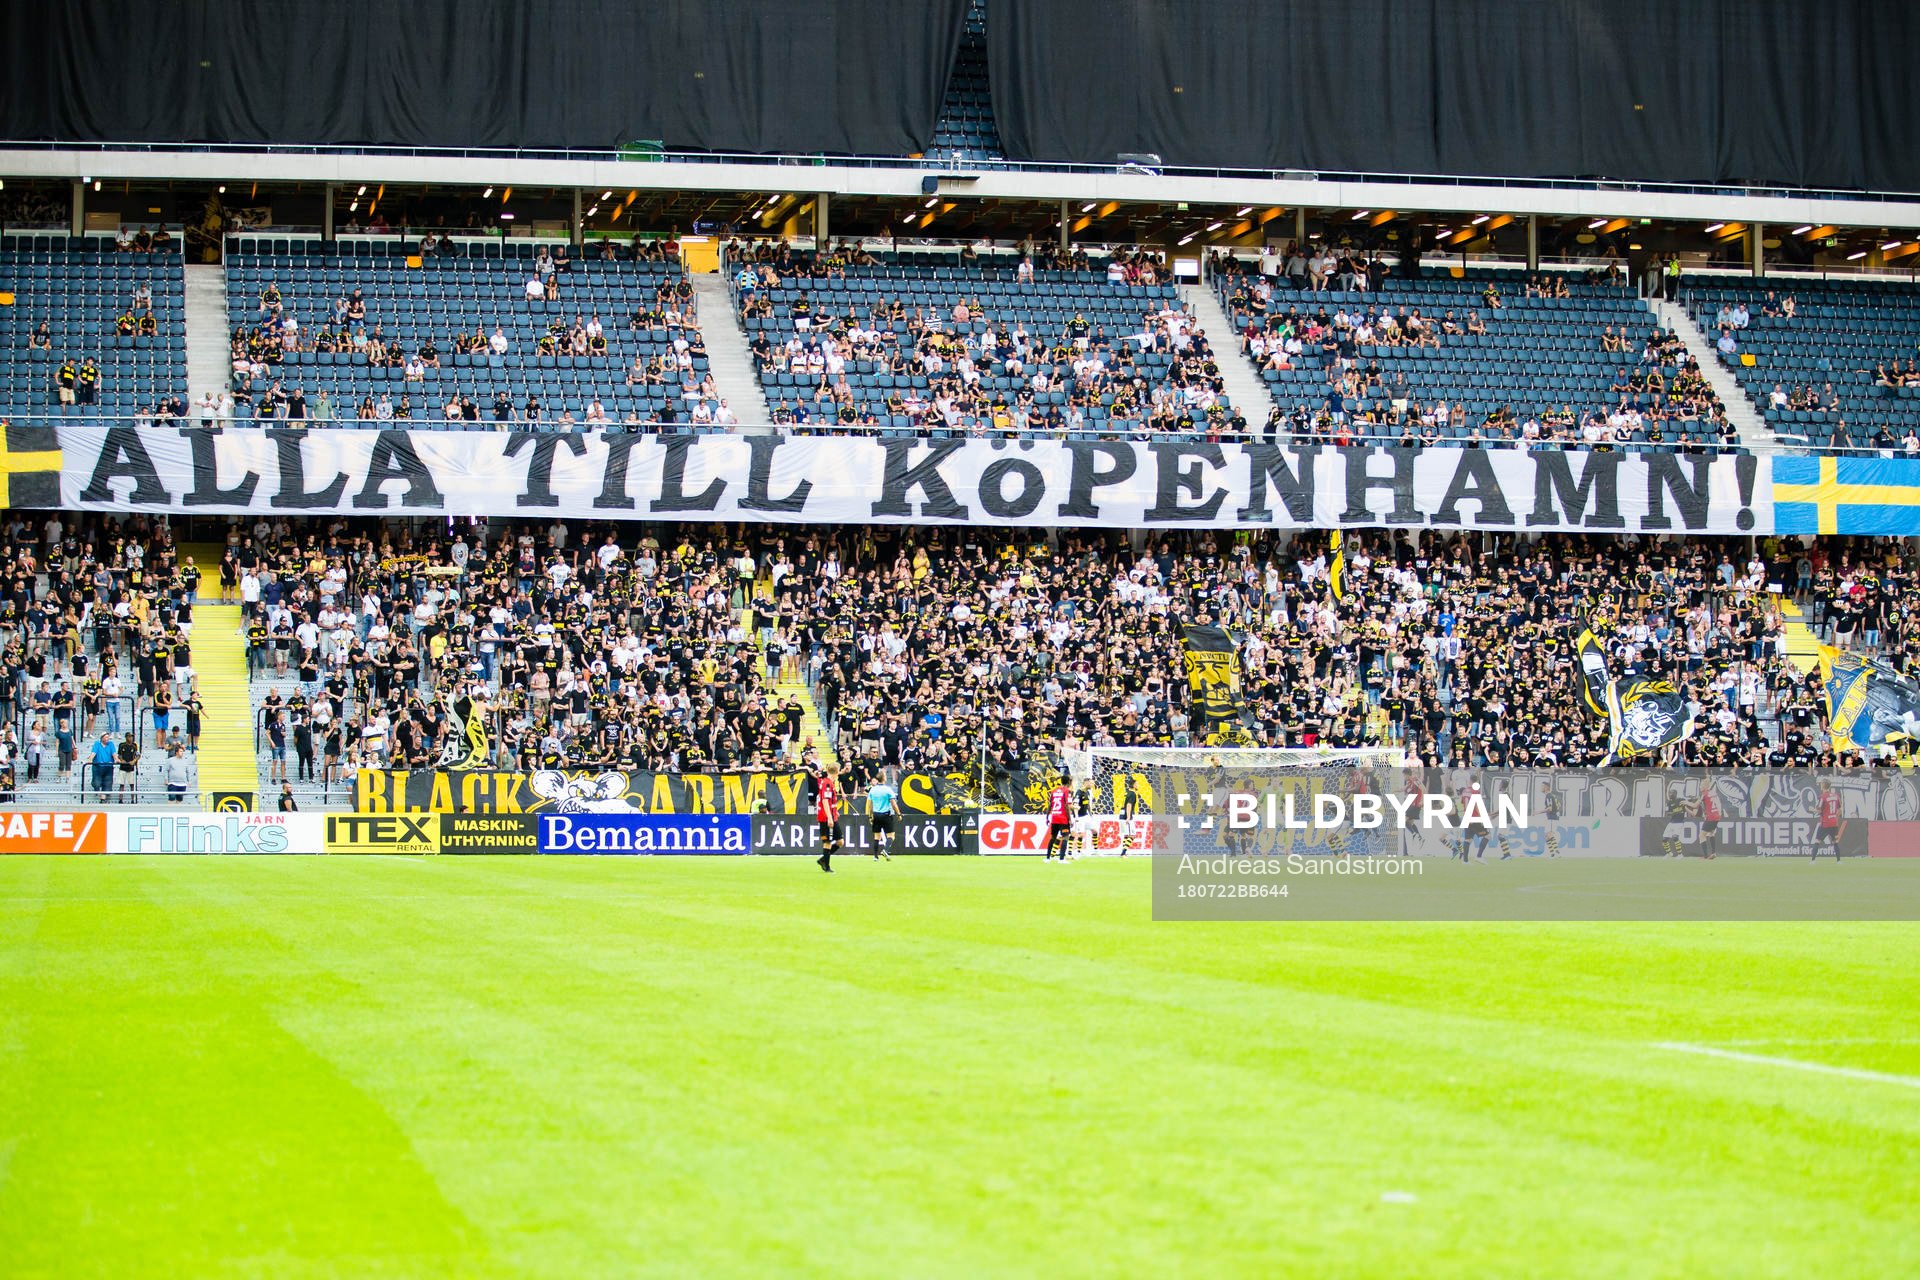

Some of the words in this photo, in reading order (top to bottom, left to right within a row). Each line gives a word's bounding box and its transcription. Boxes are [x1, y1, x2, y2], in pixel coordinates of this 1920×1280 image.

[79, 427, 445, 510] ALLA
[502, 432, 813, 513] TILL
[356, 768, 527, 814] BLACK
[650, 772, 807, 814] ARMY
[128, 817, 289, 852] Flinks
[441, 835, 538, 847] UTHYRNING
[454, 819, 525, 832] MASKIN-
[543, 815, 746, 852] Bemannia
[754, 821, 890, 849] JÄRFLLA
[904, 820, 959, 849] KÖK
[396, 844, 435, 852] RENTAL
